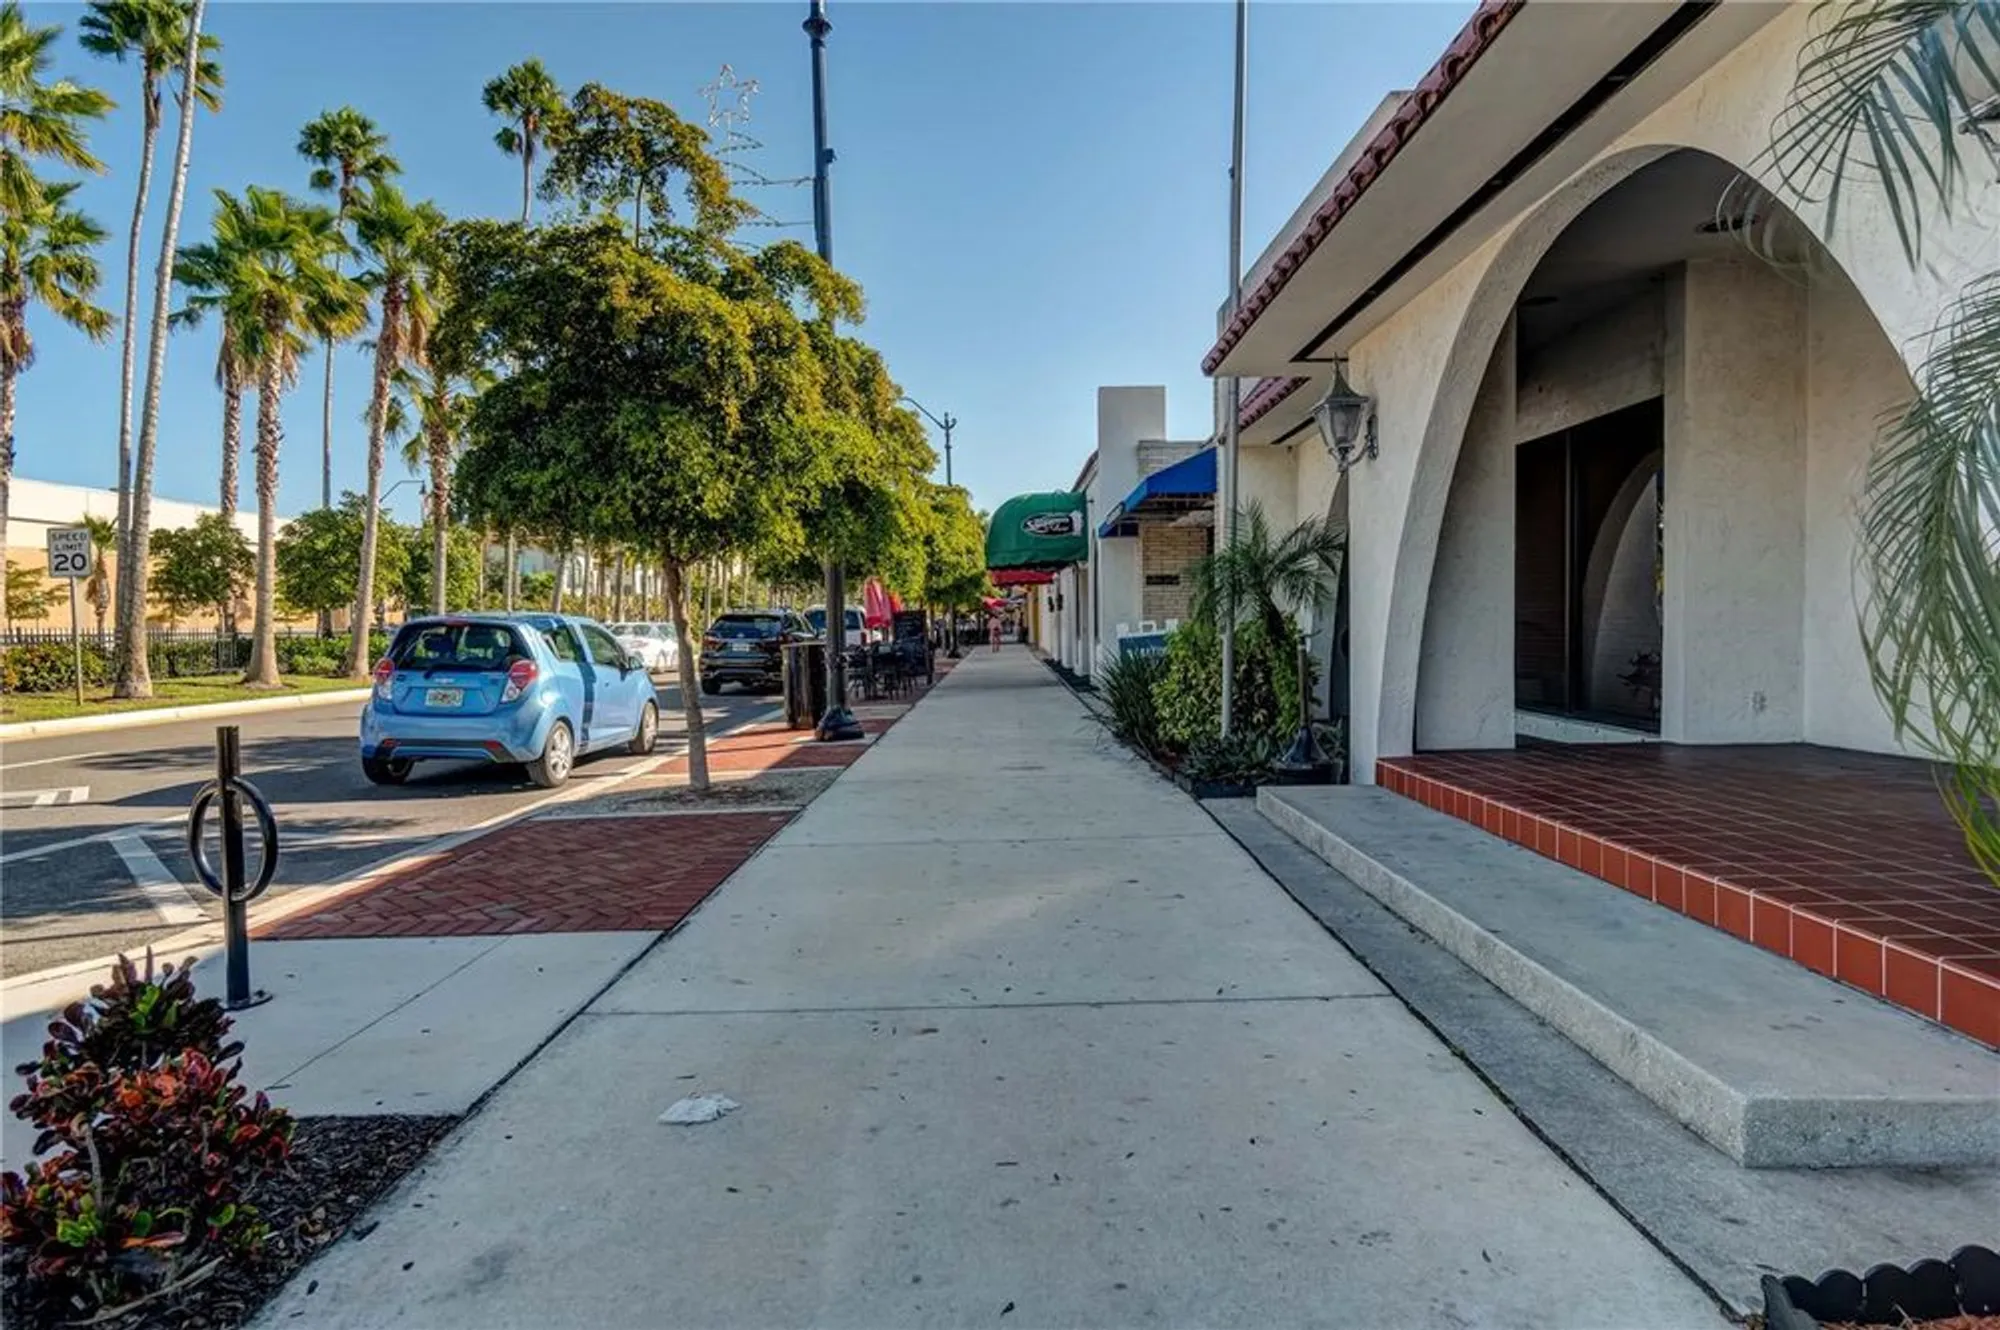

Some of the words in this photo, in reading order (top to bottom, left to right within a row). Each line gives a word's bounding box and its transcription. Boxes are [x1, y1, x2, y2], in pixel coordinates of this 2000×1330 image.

[52, 532, 87, 541] SPEED
[55, 543, 82, 551] LIMIT
[54, 553, 86, 571] 20
